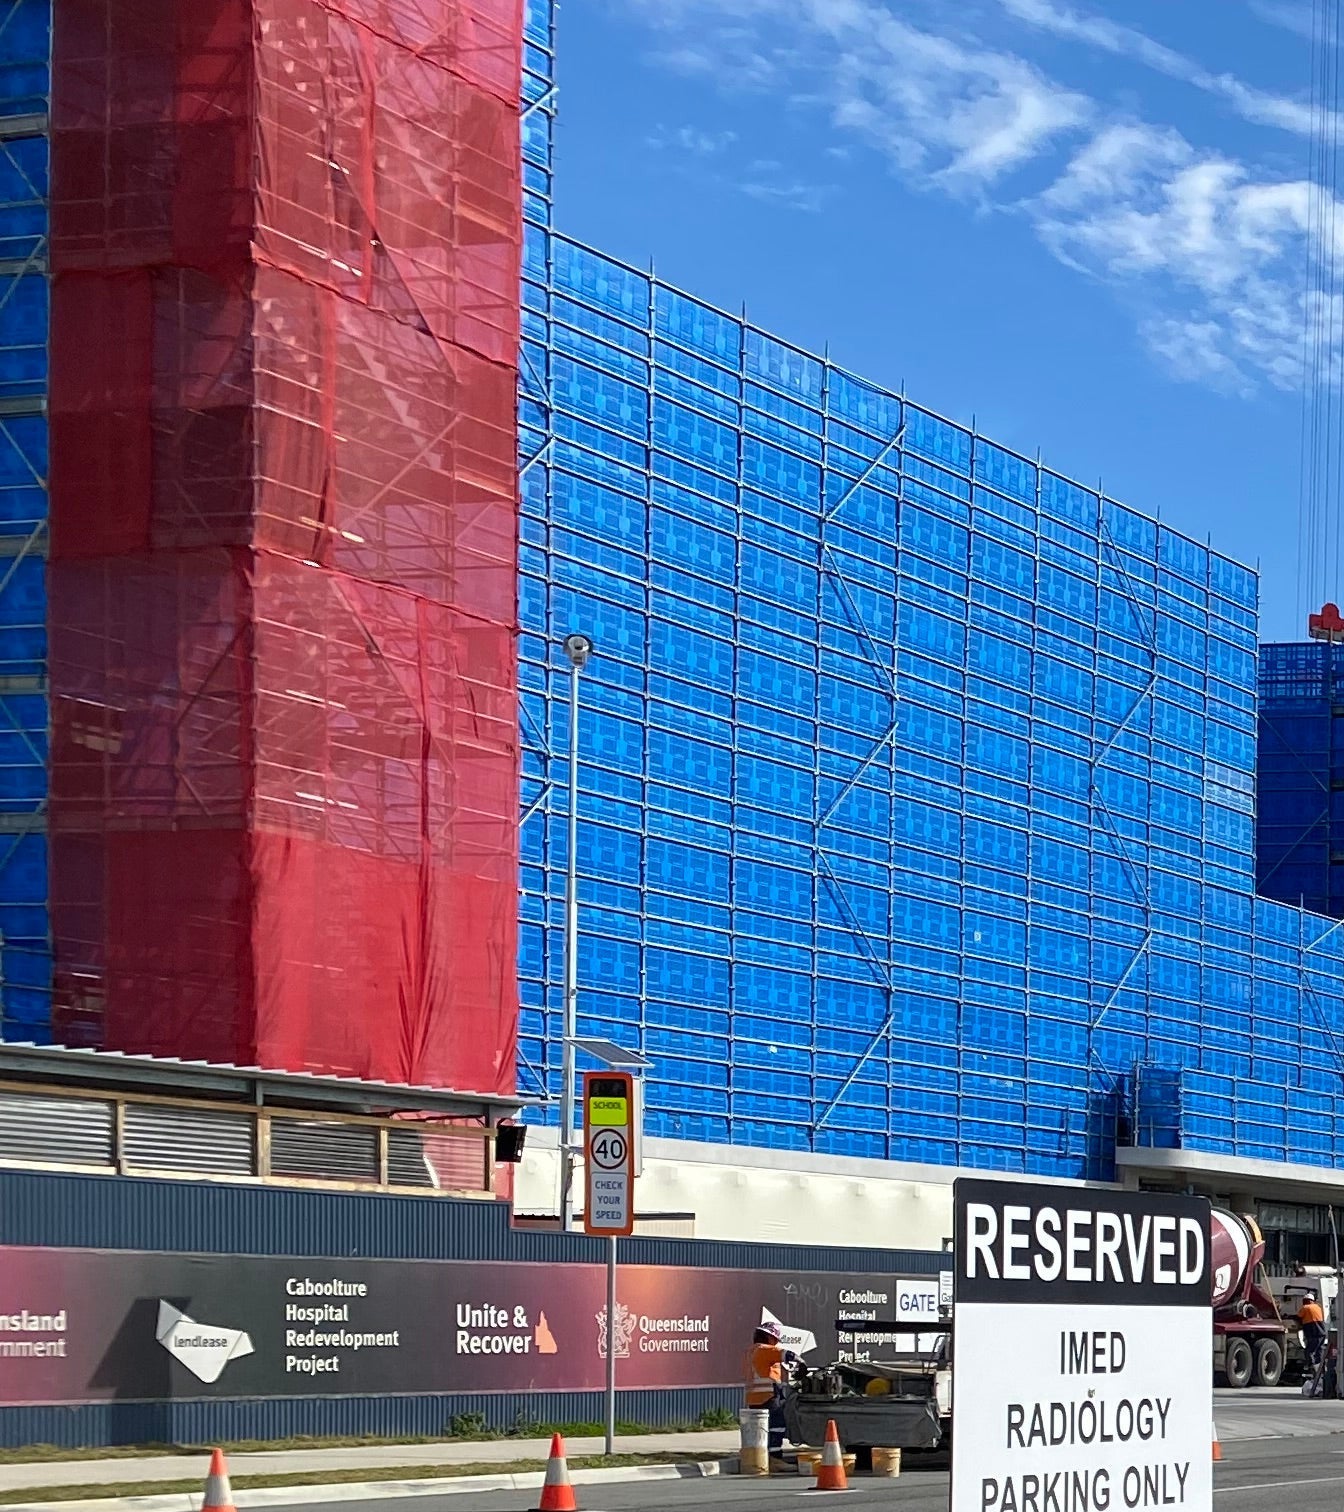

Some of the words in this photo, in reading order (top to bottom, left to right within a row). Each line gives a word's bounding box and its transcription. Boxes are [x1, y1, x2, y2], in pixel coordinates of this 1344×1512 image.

[593, 1101, 622, 1110] SCHOOL
[595, 1139, 623, 1159] 40
[595, 1181, 623, 1190] CHECK
[597, 1196, 620, 1204] YOUR
[596, 1211, 622, 1220] SPEED
[966, 1202, 1204, 1284] RESERVED
[286, 1278, 367, 1296] Caboolture
[840, 1290, 887, 1304] Caboolture
[900, 1293, 936, 1312] GATE
[0, 1310, 67, 1331] nsland
[286, 1304, 348, 1325] Hospital
[456, 1304, 508, 1328] Unite
[513, 1306, 528, 1328] &
[639, 1315, 709, 1332] Queensland
[0, 1339, 67, 1357] nment
[174, 1335, 228, 1348] lendlease
[286, 1330, 399, 1350] Redevelopment
[457, 1331, 532, 1354] Recover
[639, 1336, 709, 1352] Government
[1061, 1331, 1126, 1374] IMED
[286, 1356, 339, 1376] Project
[1007, 1398, 1171, 1448] RADIOLOGY
[1123, 1462, 1190, 1508] ONLY
